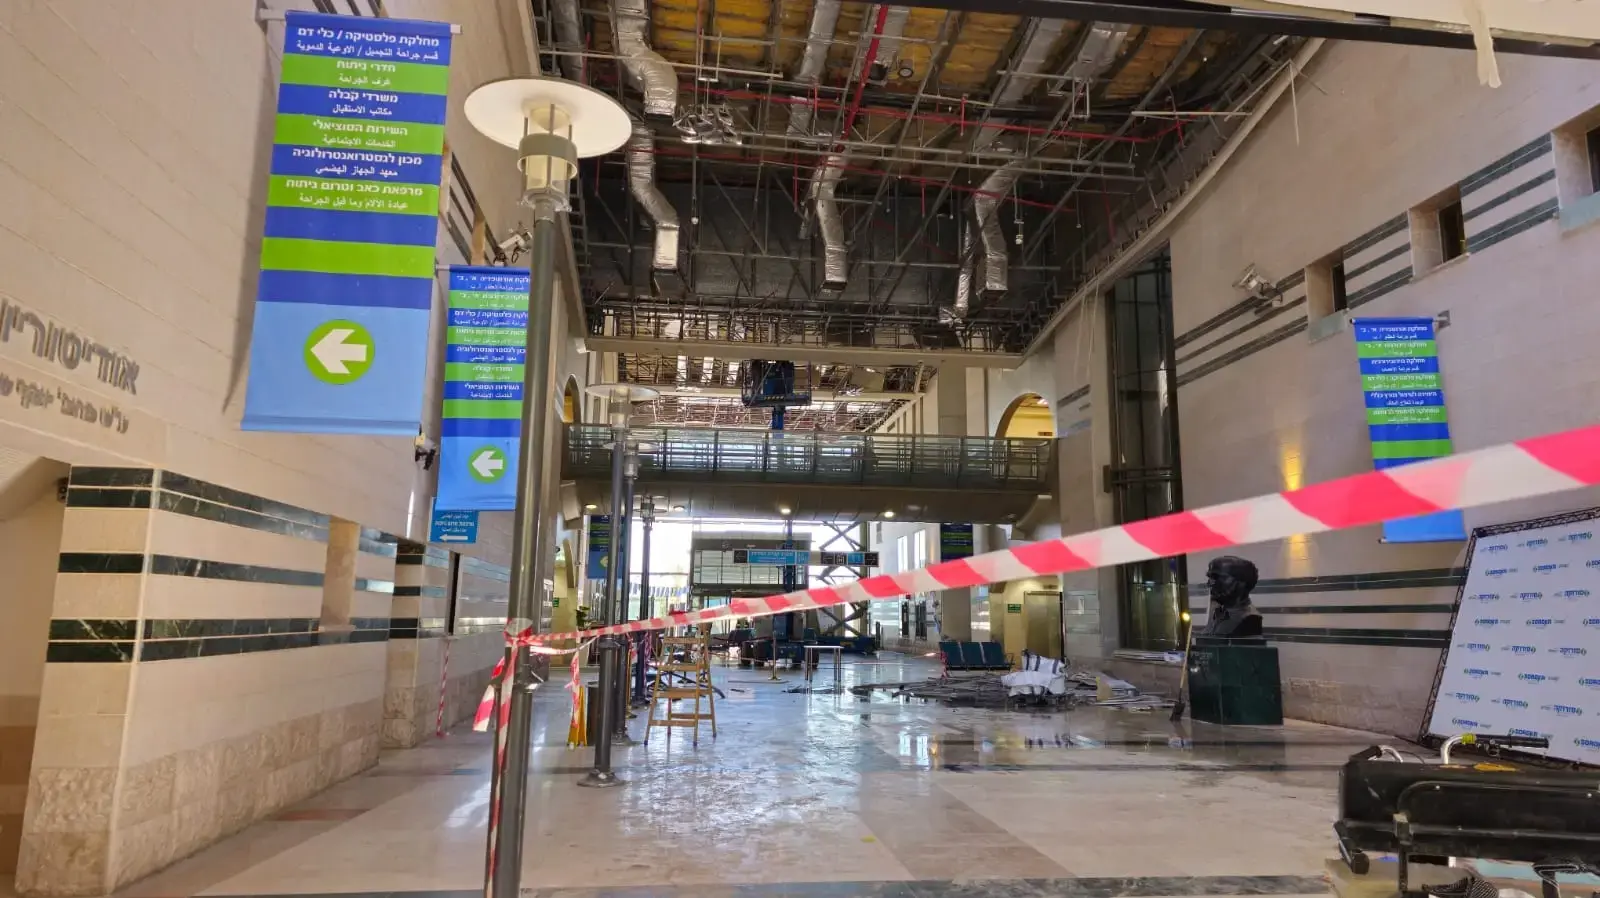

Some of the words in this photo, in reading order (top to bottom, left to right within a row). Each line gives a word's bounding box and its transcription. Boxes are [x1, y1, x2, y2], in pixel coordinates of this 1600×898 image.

[297, 27, 315, 36] דם
[317, 27, 335, 38] כלי
[337, 30, 343, 40] /
[345, 31, 397, 44] פלסטיקה
[399, 35, 440, 47] מחלקת
[336, 60, 367, 71] ניתוח
[370, 63, 396, 72] חדרי
[328, 88, 360, 102] קבלה
[362, 92, 398, 103] משרדי
[313, 119, 363, 132] הסוציאלי
[366, 124, 408, 136] השירות
[398, 156, 422, 166] מכון
[286, 179, 318, 189] ניתוח
[321, 182, 354, 192] וטרום
[356, 184, 380, 193] כאב
[382, 186, 424, 196] מרפאת
